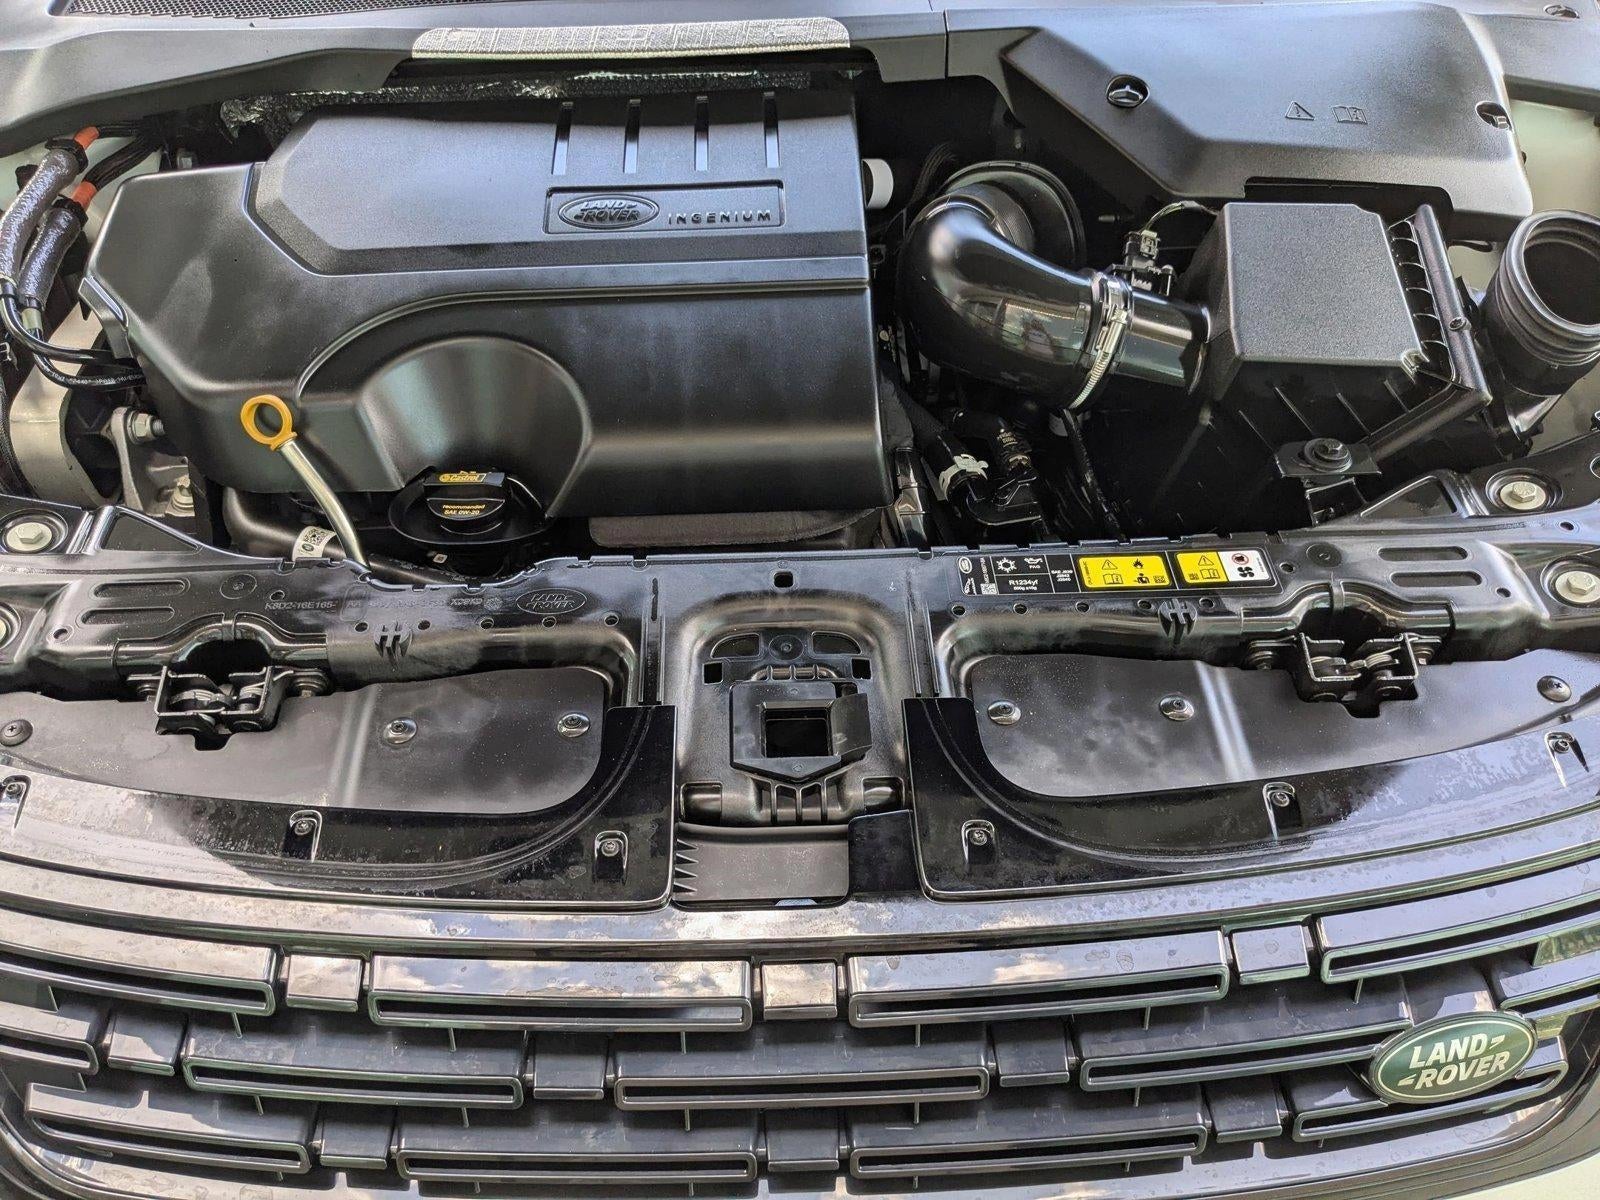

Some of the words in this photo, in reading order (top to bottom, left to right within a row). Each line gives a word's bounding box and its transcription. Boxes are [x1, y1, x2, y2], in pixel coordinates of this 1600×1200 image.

[581, 200, 628, 211] LAND
[583, 209, 641, 222] ROVER
[668, 210, 772, 225] INGENIUM
[449, 473, 480, 482] Castrol
[1008, 579, 1039, 587] R1234yf
[1409, 1033, 1488, 1069] LAND
[1415, 1051, 1511, 1090] ROVER
